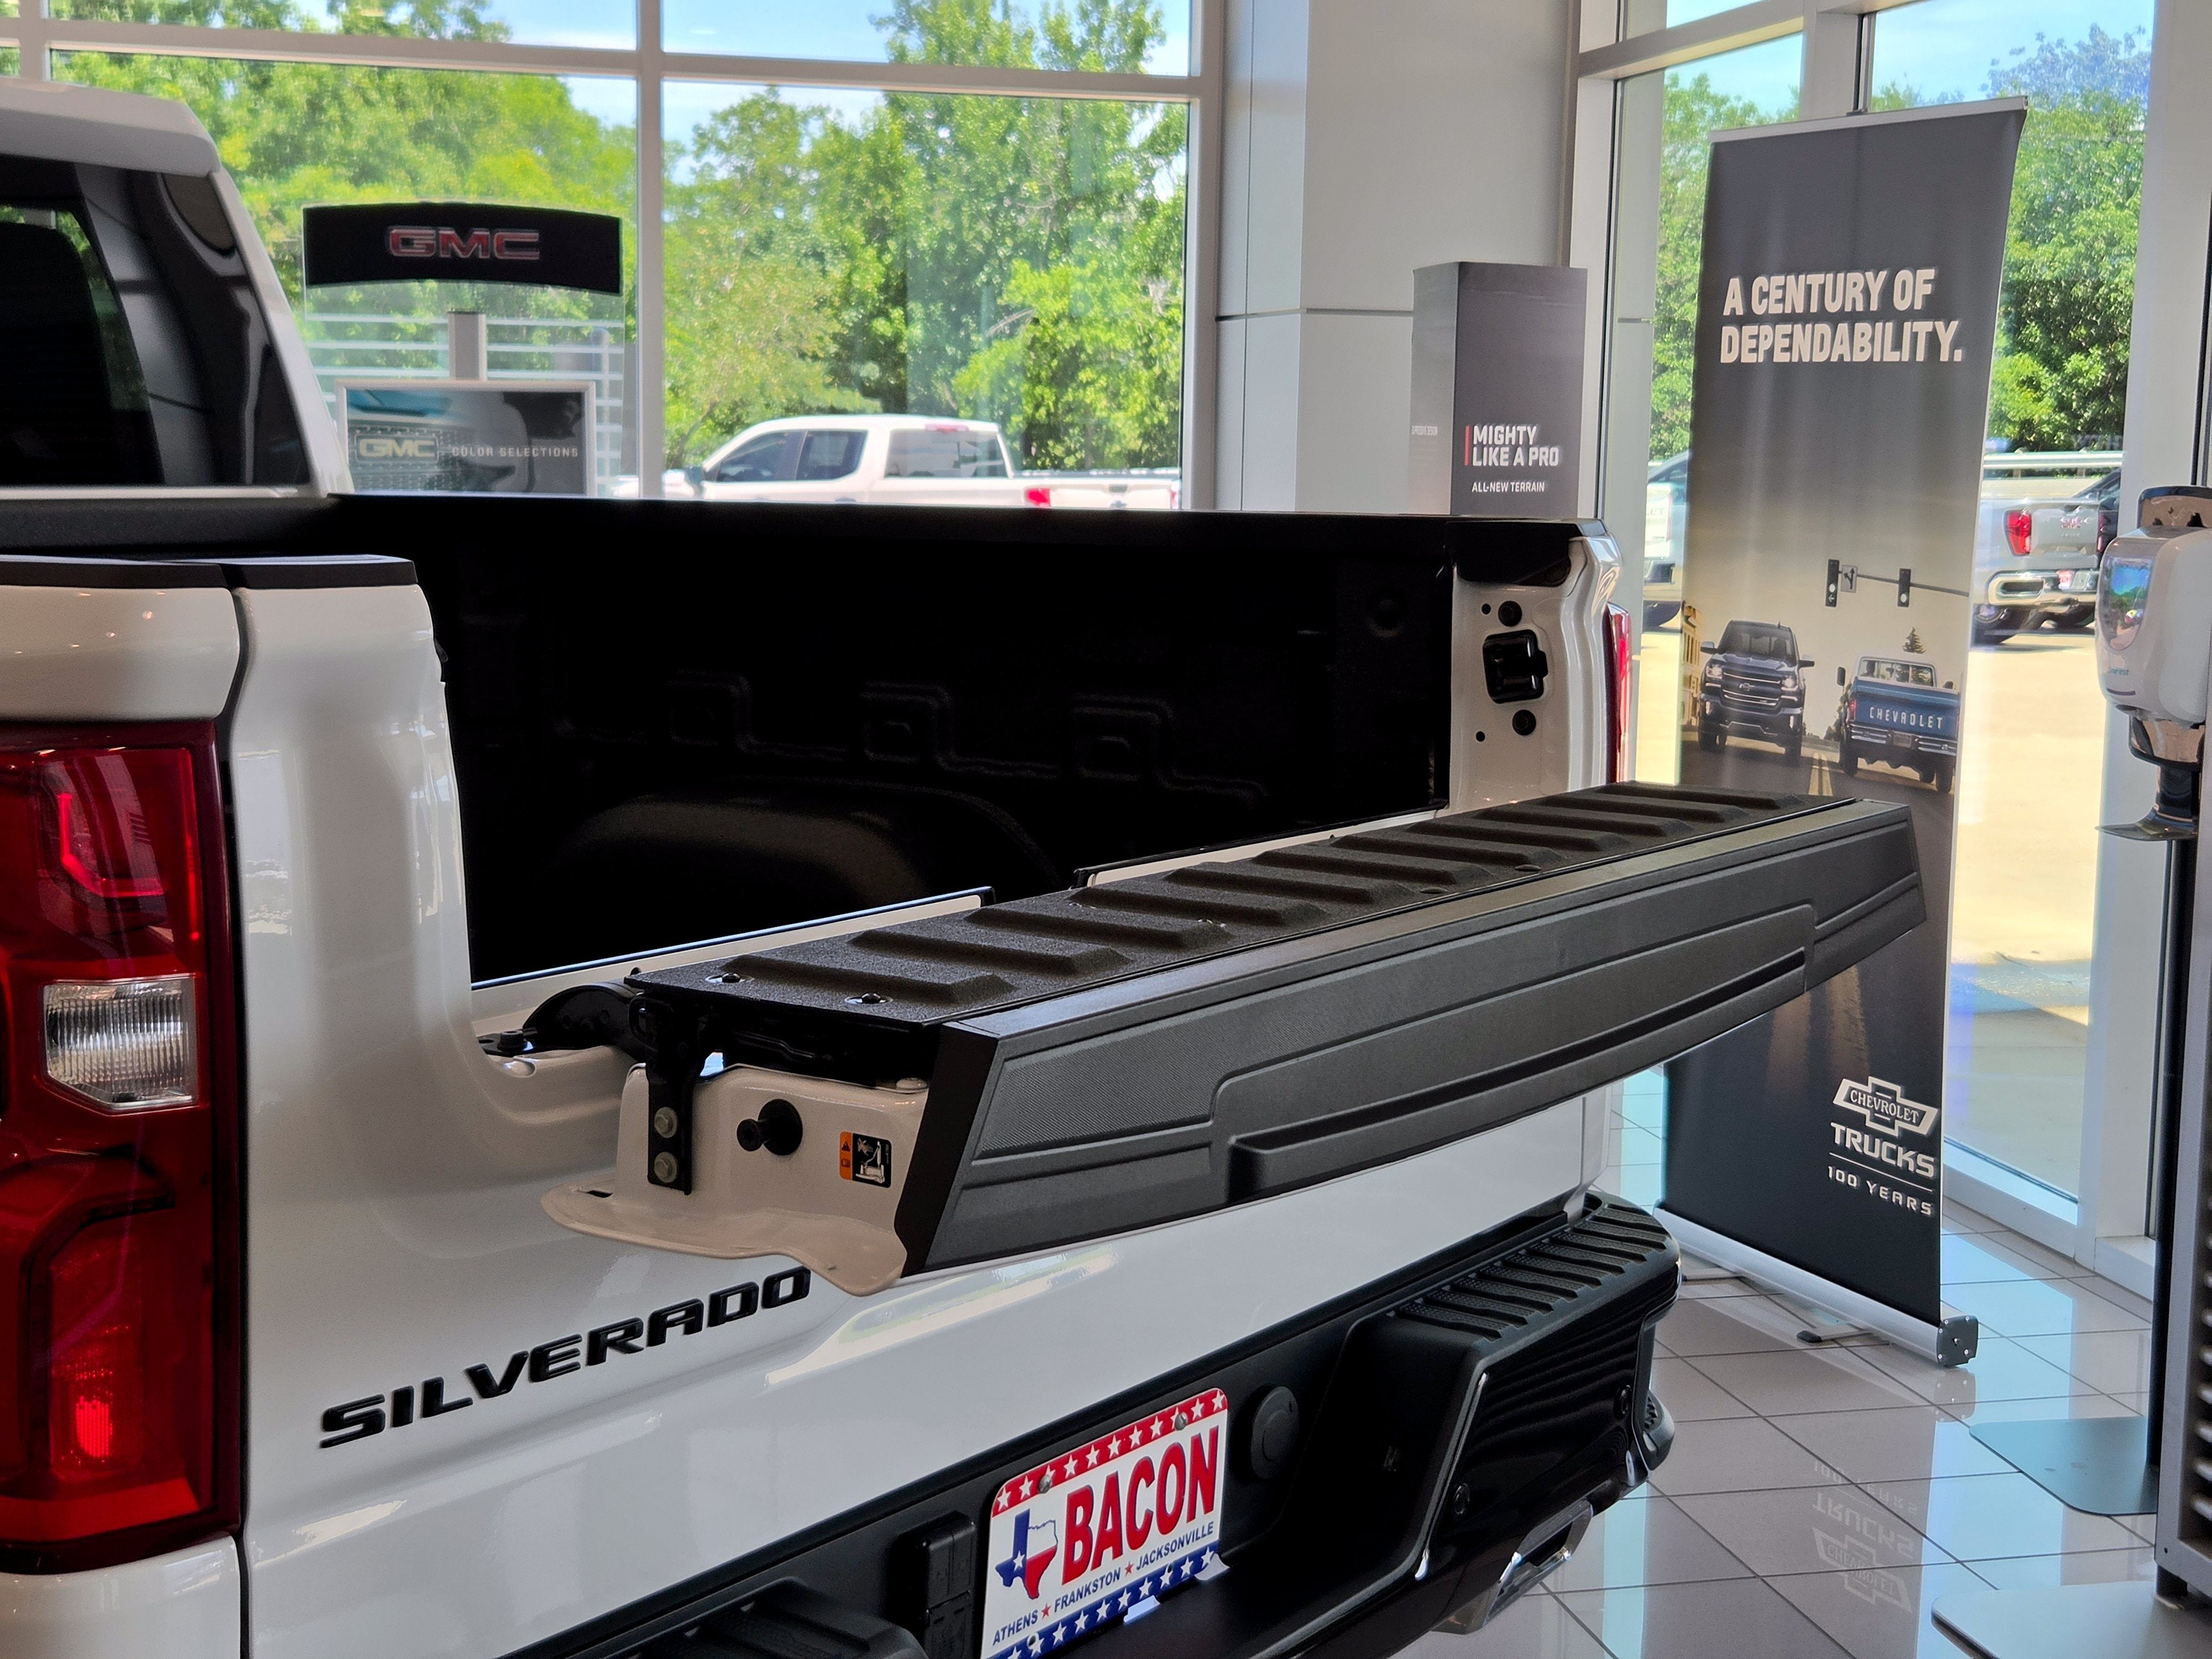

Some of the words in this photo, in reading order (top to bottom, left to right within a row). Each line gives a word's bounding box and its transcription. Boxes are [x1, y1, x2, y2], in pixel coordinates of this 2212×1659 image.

[389, 227, 540, 260] GMC
[1723, 278, 1744, 316] A
[1751, 270, 1887, 315] CENTURY
[1893, 268, 1936, 311] OF
[1720, 320, 1962, 363] DEPENDABILITY.
[359, 439, 435, 457] GMC
[452, 446, 494, 457] COLOR
[500, 446, 578, 458] SELECTIONS
[1473, 425, 1537, 445] MIGHTY
[1472, 447, 1509, 466] LIKE
[1513, 447, 1525, 466] A
[1528, 447, 1559, 466] PRO
[1472, 482, 1509, 492] ALL-NEW
[1510, 482, 1545, 492] TERRAIN
[1869, 706, 1943, 729] CHEVROLET
[1850, 1089, 1919, 1124] CHEVROLET
[1830, 1121, 1934, 1178] TRUCKS
[1828, 1165, 1857, 1187] 100
[1866, 1180, 1932, 1215] YEARS
[319, 1265, 811, 1448] SILVERADO
[1061, 1425, 1219, 1585] BACON
[992, 1609, 1039, 1646] ATHENS
[1053, 1567, 1121, 1613] FRANKSTON
[1136, 1521, 1215, 1571] JACKSONVILLE
